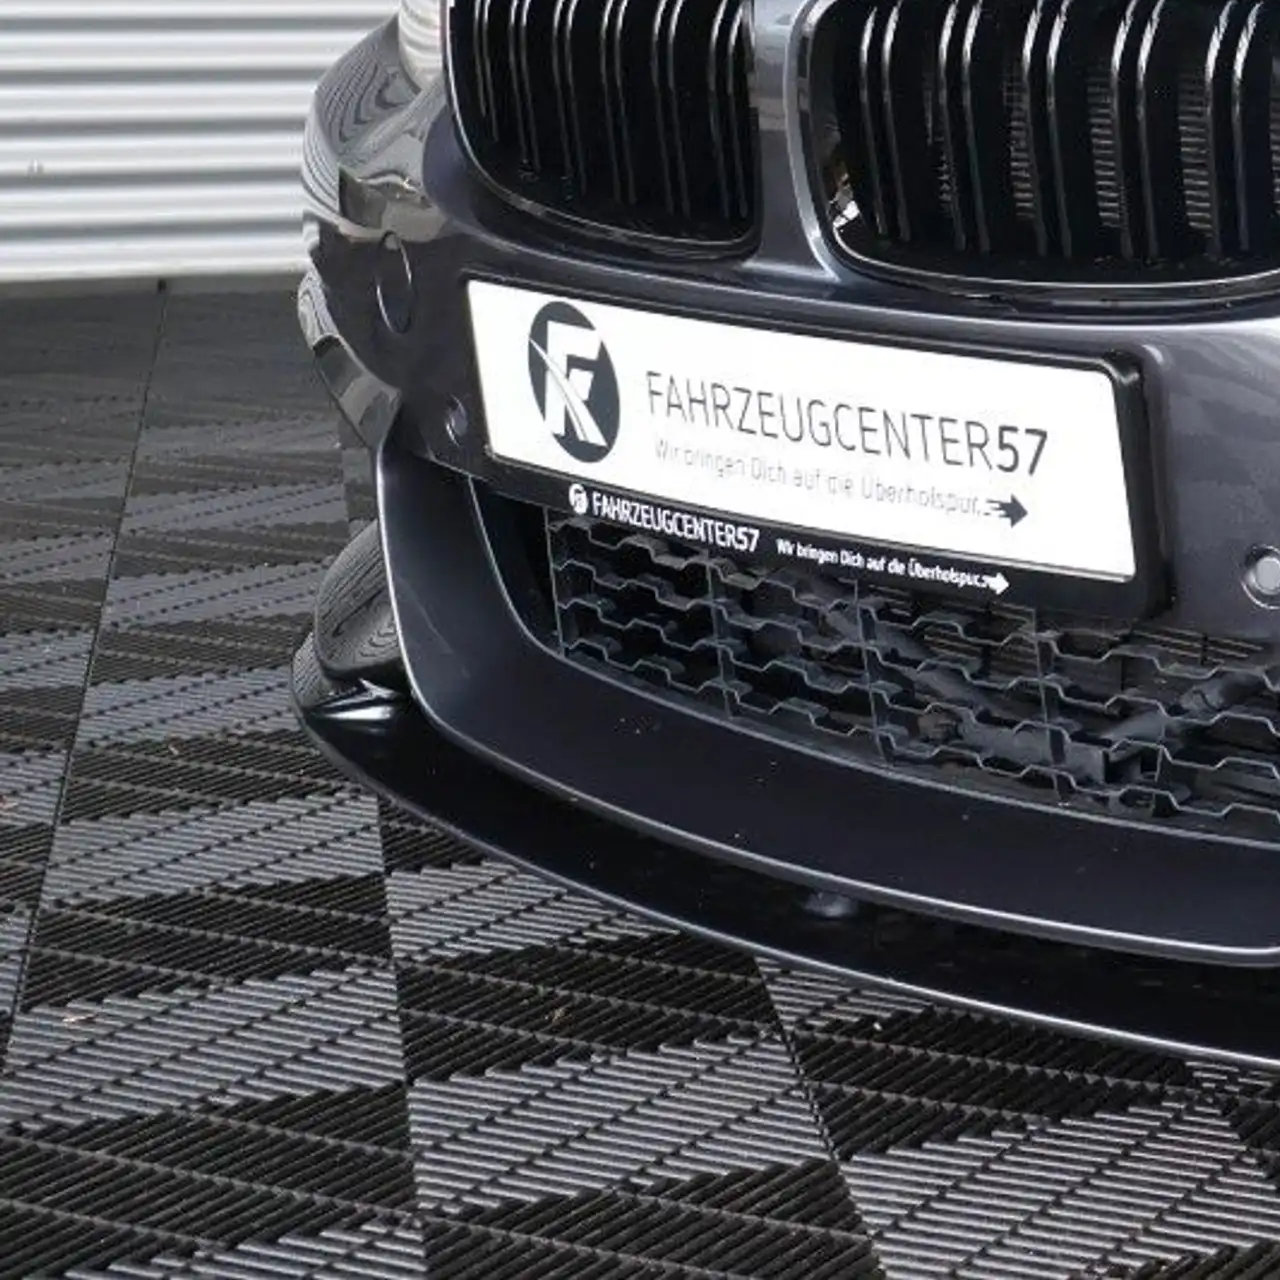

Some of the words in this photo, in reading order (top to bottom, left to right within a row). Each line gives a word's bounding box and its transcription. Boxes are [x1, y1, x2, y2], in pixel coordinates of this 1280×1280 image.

[646, 370, 1048, 476] FAHRZEUGCENTER57
[655, 439, 680, 462] Wir
[751, 457, 786, 485] Dich
[592, 491, 760, 552] FAHRZEUGCENTER57
[775, 538, 794, 554] Wir
[797, 541, 839, 565] bringen
[840, 549, 865, 569] Dich
[867, 555, 885, 571] auf
[888, 558, 905, 576] die
